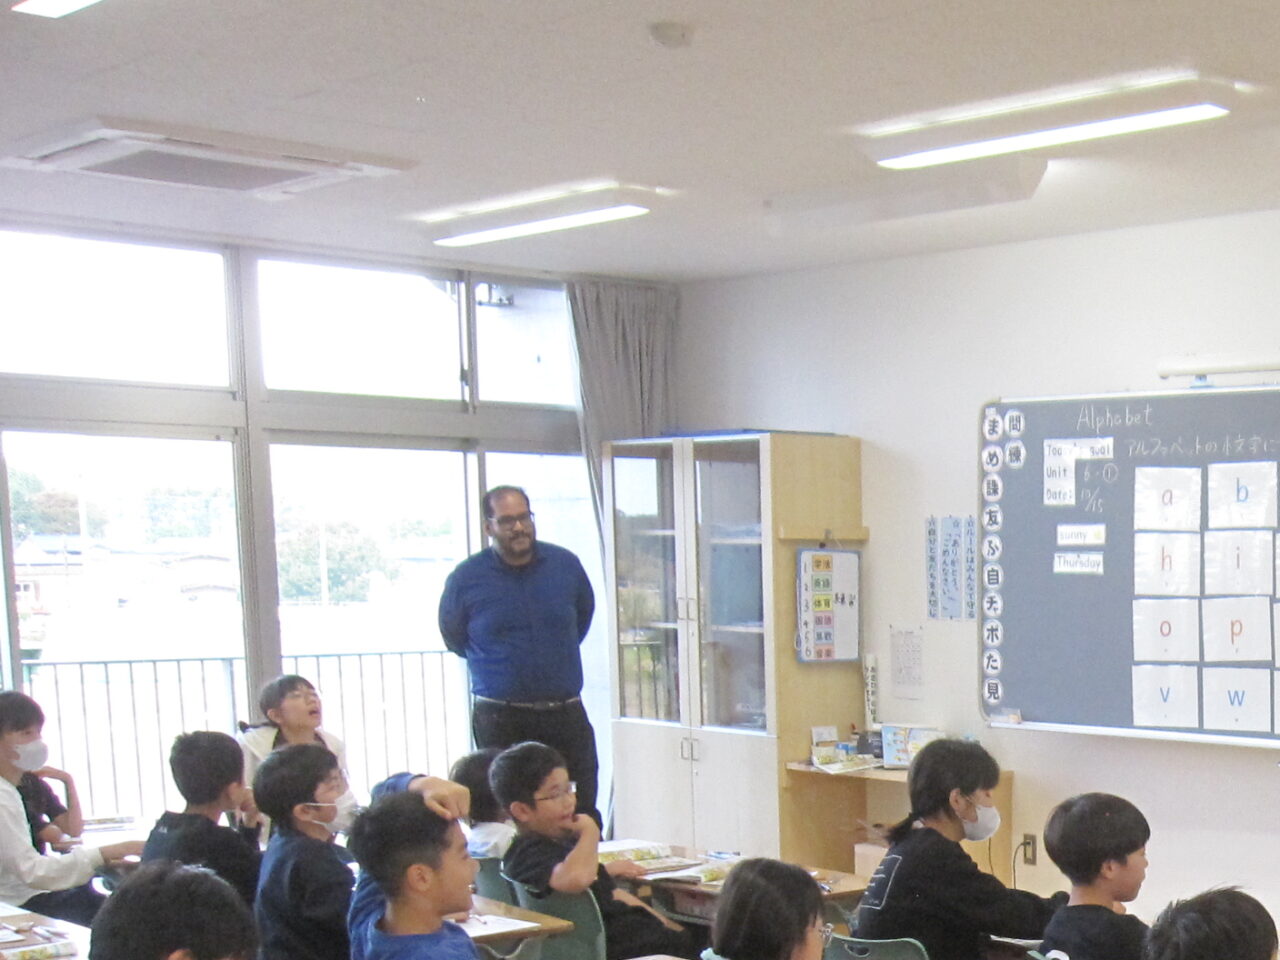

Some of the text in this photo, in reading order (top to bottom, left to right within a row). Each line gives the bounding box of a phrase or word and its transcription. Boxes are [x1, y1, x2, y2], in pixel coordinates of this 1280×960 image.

[987, 417, 1000, 436] ま
[1008, 414, 1022, 433] 問
[1076, 403, 1152, 434] Alphabet
[985, 449, 1000, 467] め
[1046, 466, 1067, 479] Unit
[1046, 489, 1073, 501] Date:
[1161, 488, 1173, 506] a
[1236, 477, 1249, 503] b
[985, 508, 999, 527] 友
[1059, 531, 1088, 542] sunny
[986, 539, 1000, 557] ふ
[1056, 555, 1101, 572] Thursday
[1161, 545, 1173, 571] h
[987, 567, 1000, 586] 自
[1159, 620, 1172, 638] o
[1230, 619, 1243, 645] p
[986, 653, 999, 671] た
[987, 682, 1000, 700] 見
[1159, 687, 1171, 703] v
[1227, 690, 1246, 707] w
